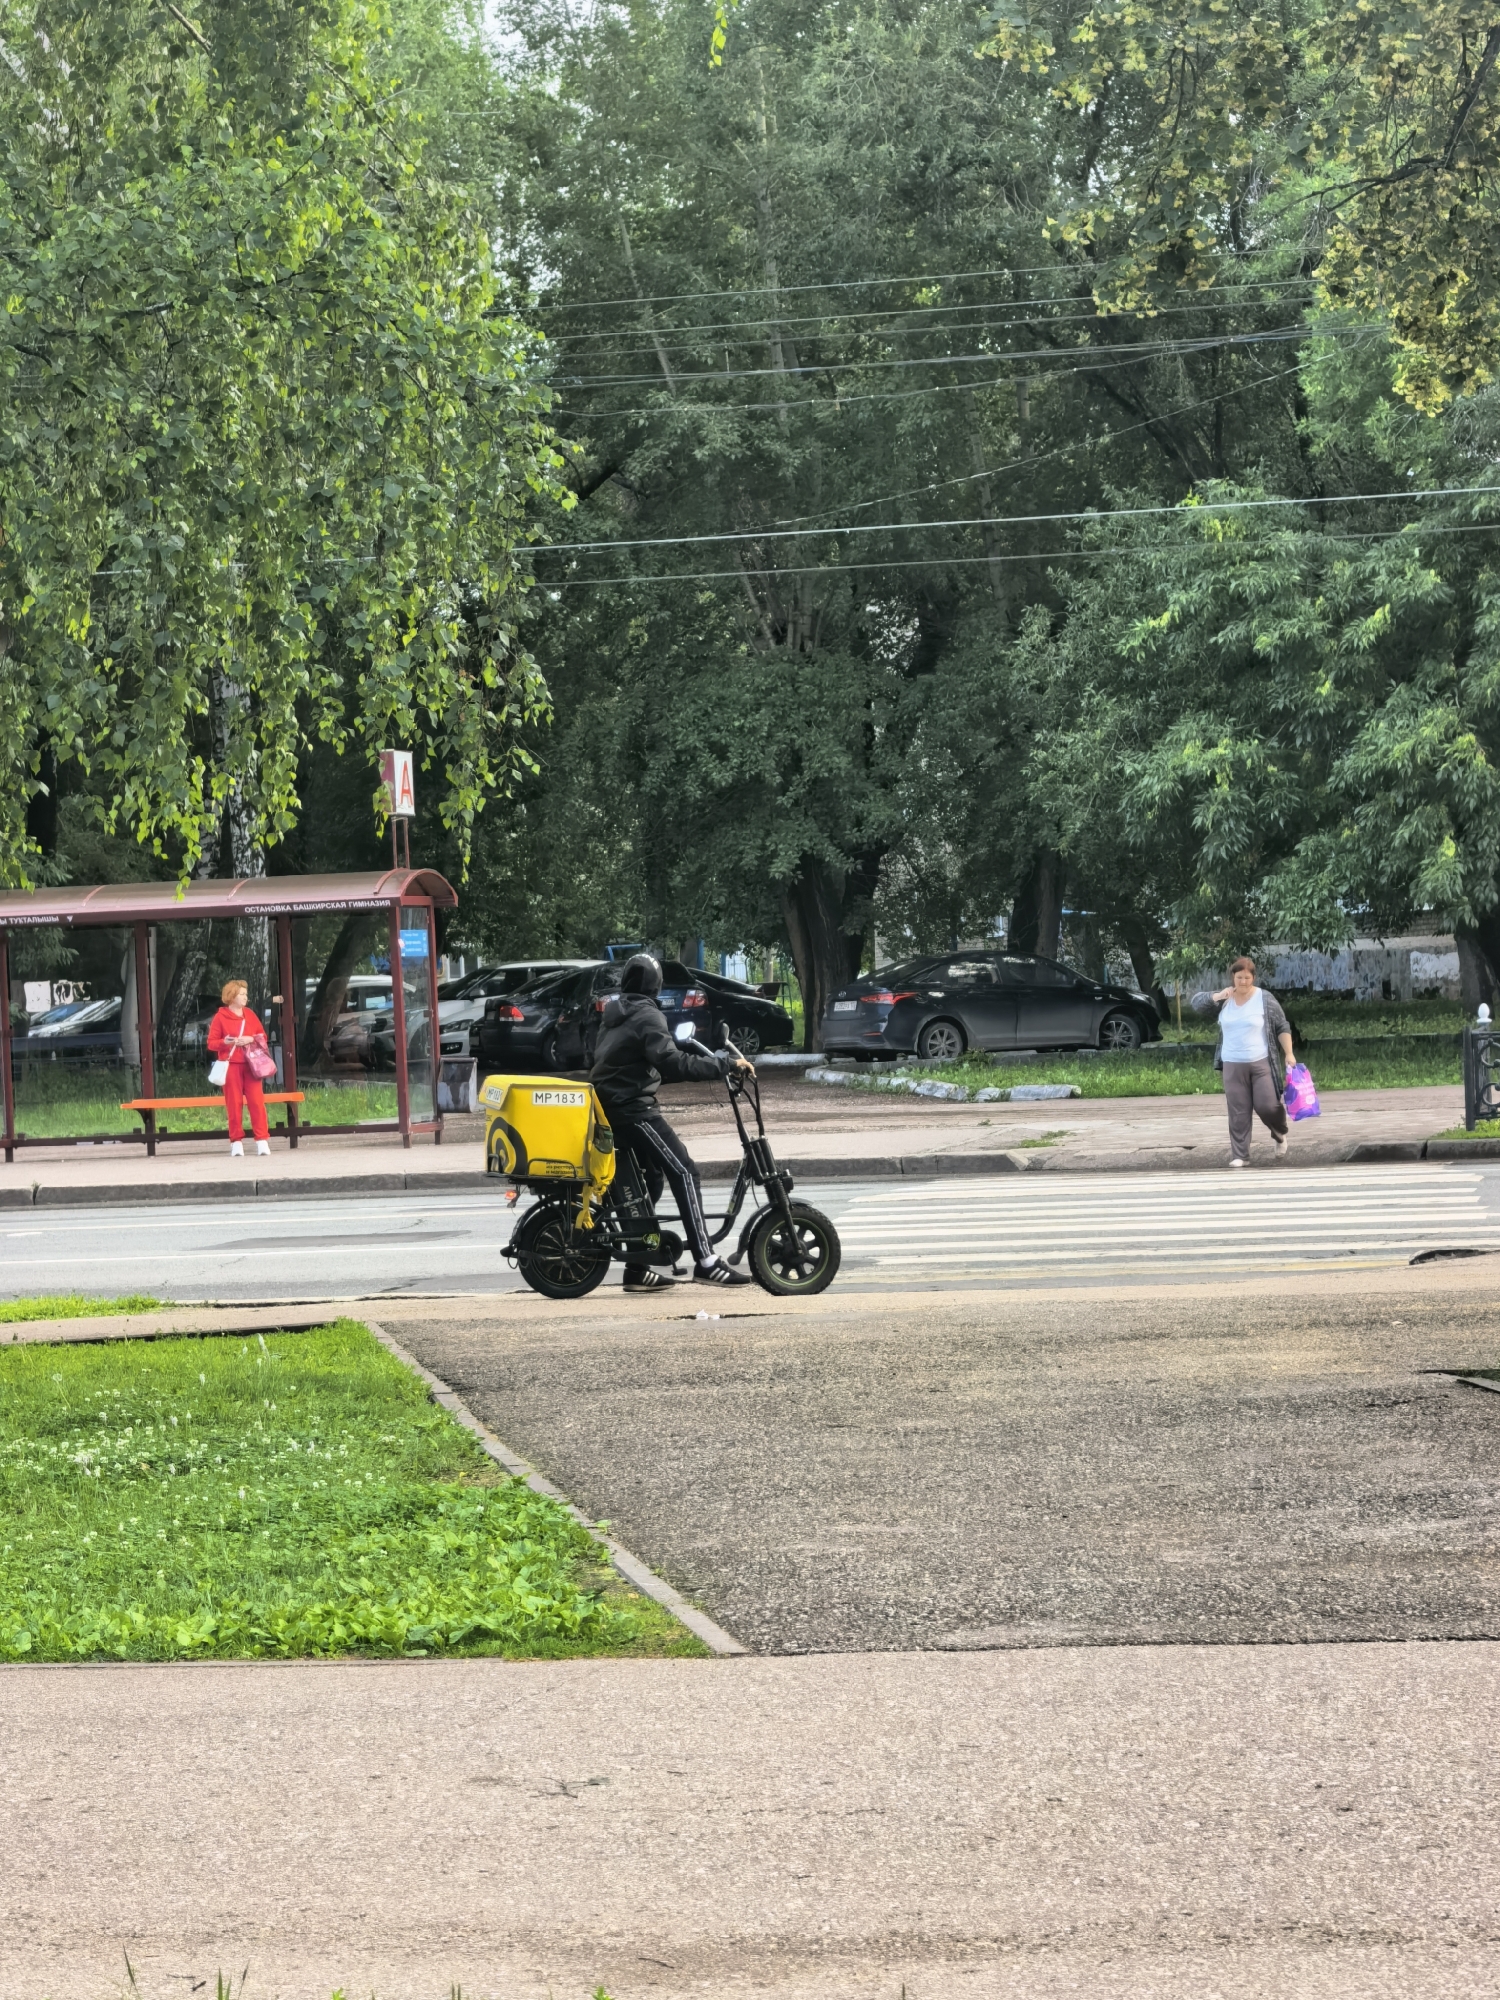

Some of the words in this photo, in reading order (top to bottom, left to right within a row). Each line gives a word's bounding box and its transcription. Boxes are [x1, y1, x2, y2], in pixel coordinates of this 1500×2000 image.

[400, 760, 413, 807] А
[245, 904, 292, 914] ОСТАНОВКА
[293, 901, 347, 911] БАШКИРСКАЯ
[348, 899, 391, 908] ГИМНАЗИЯ
[9, 915, 59, 924] ТУКТАЛЫШЫ
[535, 1092, 584, 1104] MP1831
